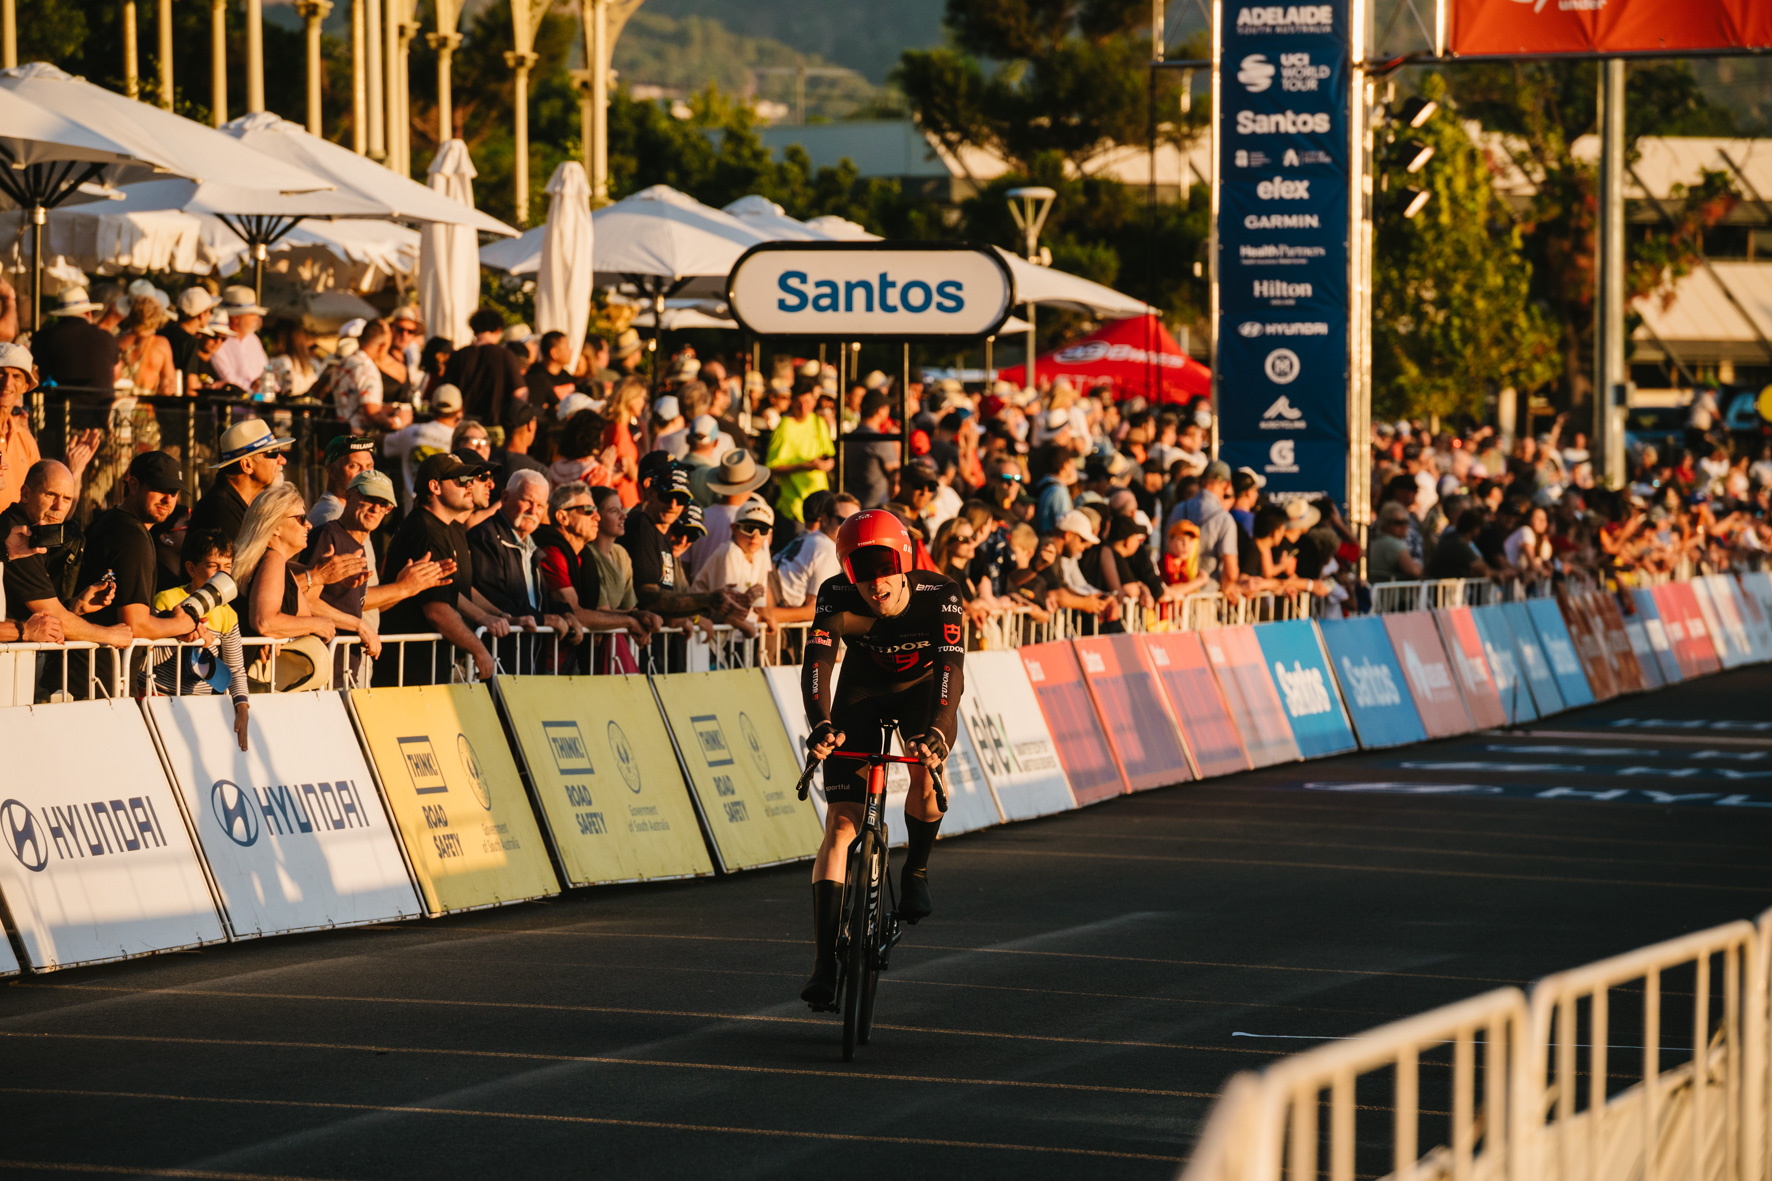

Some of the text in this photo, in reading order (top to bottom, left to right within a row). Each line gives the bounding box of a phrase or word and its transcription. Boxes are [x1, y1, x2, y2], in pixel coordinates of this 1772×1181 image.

[1237, 6, 1332, 26] ADELAIDE
[1280, 53, 1309, 66] UCI
[1281, 66, 1330, 79] WORLD
[1282, 79, 1318, 91] TOUR
[1237, 110, 1330, 134] Santos
[1244, 214, 1320, 229] GARMIN
[777, 270, 964, 313] Santos
[1253, 280, 1312, 298] Hilton
[1265, 322, 1328, 335] HYUNDAI
[941, 604, 963, 615] MSC
[938, 645, 964, 653] TUDOR
[811, 668, 819, 694] TUDOR
[941, 672, 950, 699] TUDOR
[1275, 660, 1331, 717] Santos
[1341, 655, 1400, 707] Santos
[551, 736, 585, 759] THINK!
[698, 729, 726, 751] THINK!
[407, 753, 439, 777] THINK!
[564, 784, 593, 807] ROAD
[712, 775, 736, 797] ROAD
[252, 780, 370, 836] HYUNDAI
[421, 804, 449, 829] ROAD
[628, 804, 658, 816] Government
[723, 800, 750, 823] SAFETY
[867, 796, 877, 825] BMC
[41, 795, 168, 860] HYUNDAI
[481, 822, 509, 836] Government
[575, 812, 608, 835] SAFETY
[633, 820, 650, 831] South
[649, 818, 671, 831] Australia
[432, 833, 464, 859] SAFETY
[488, 838, 502, 852] South
[501, 837, 521, 851] Australia
